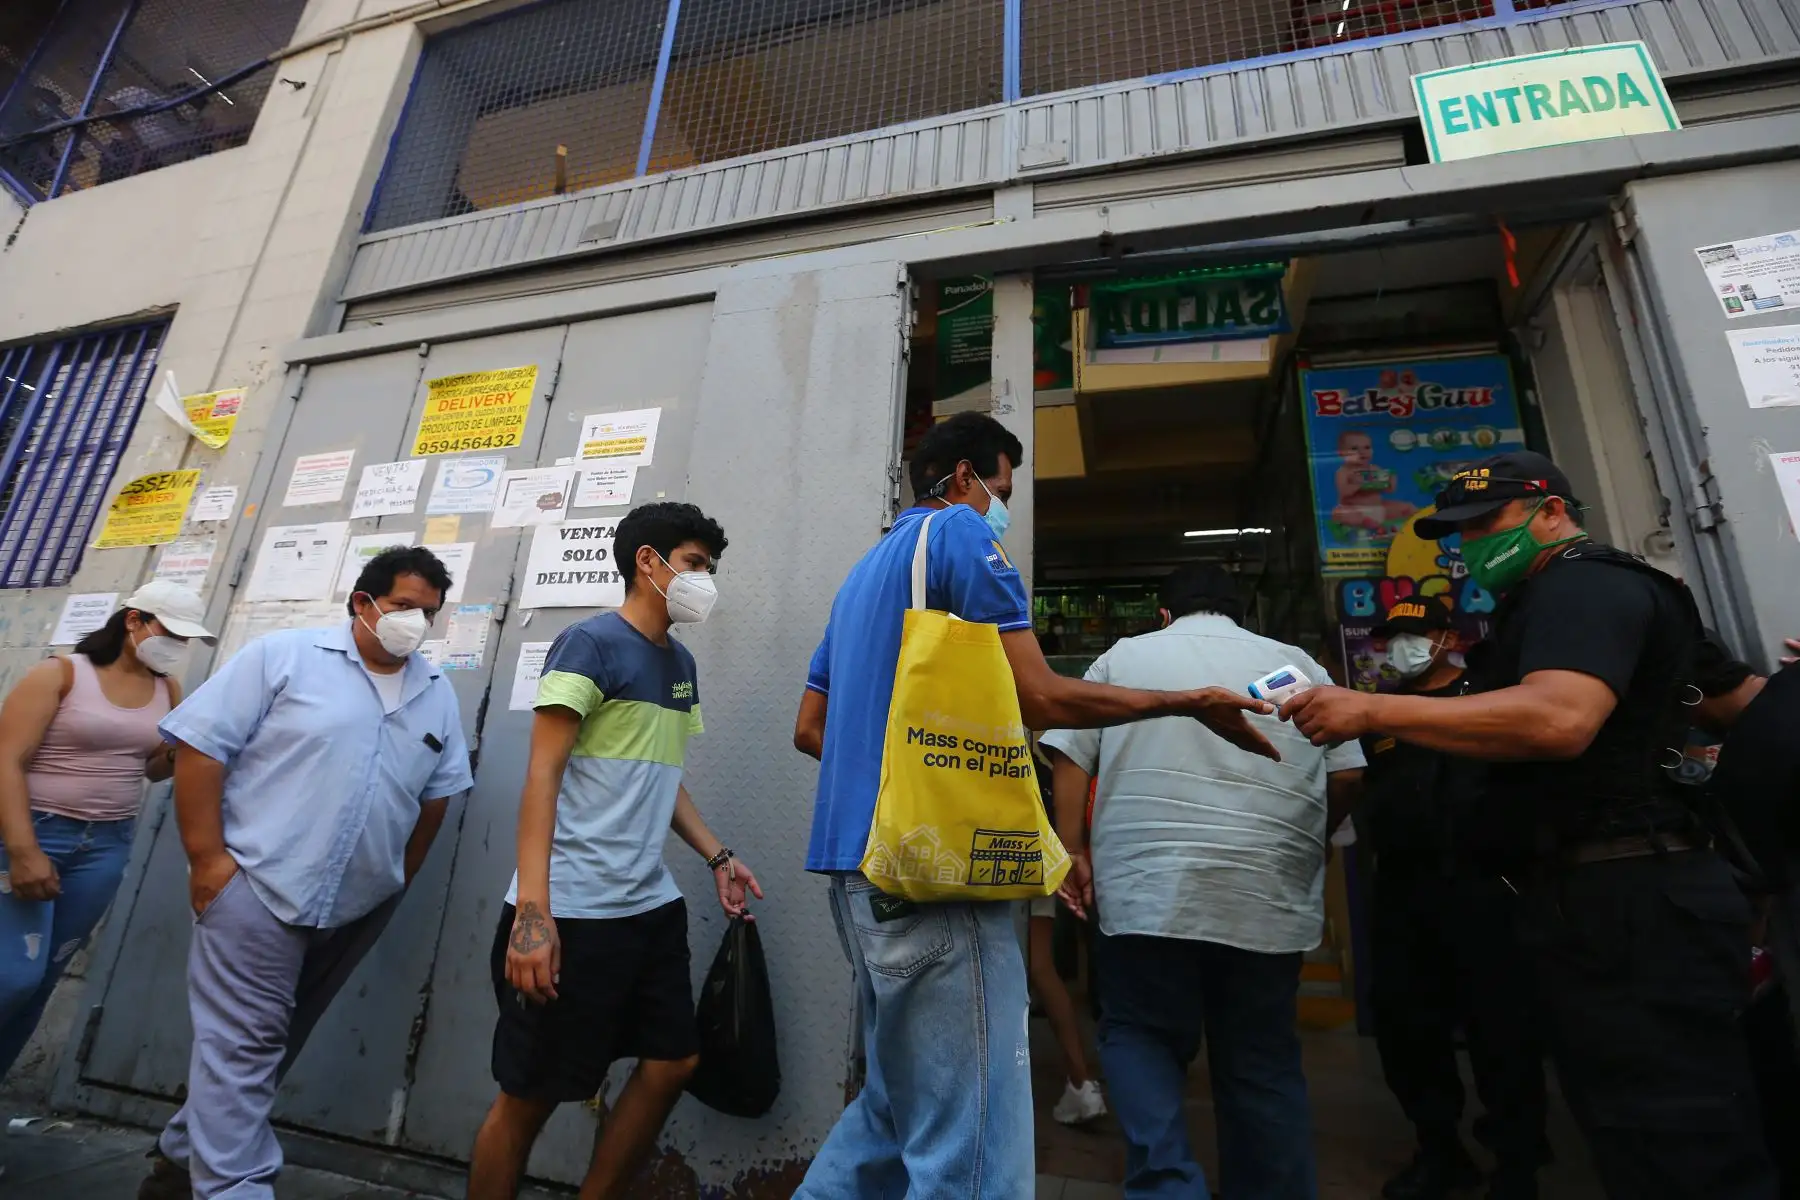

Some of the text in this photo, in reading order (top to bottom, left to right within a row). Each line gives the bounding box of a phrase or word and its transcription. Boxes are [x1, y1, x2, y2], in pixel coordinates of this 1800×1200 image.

[1439, 72, 1650, 135] ENTRADA
[944, 281, 986, 295] Panadol
[438, 391, 517, 412] DELIVERY
[1312, 383, 1493, 418] BabyGuu
[420, 415, 522, 435] PRODUCTOS DE LIMPIEZA
[418, 433, 516, 455] 959456432
[121, 472, 199, 494] SSENIA
[560, 526, 616, 540] VENTA
[562, 549, 608, 561] SOLO
[536, 571, 621, 585] DELIVERY
[907, 726, 958, 749] Mass
[923, 753, 960, 769] con
[966, 756, 984, 771] el
[989, 838, 1023, 850] Mass
